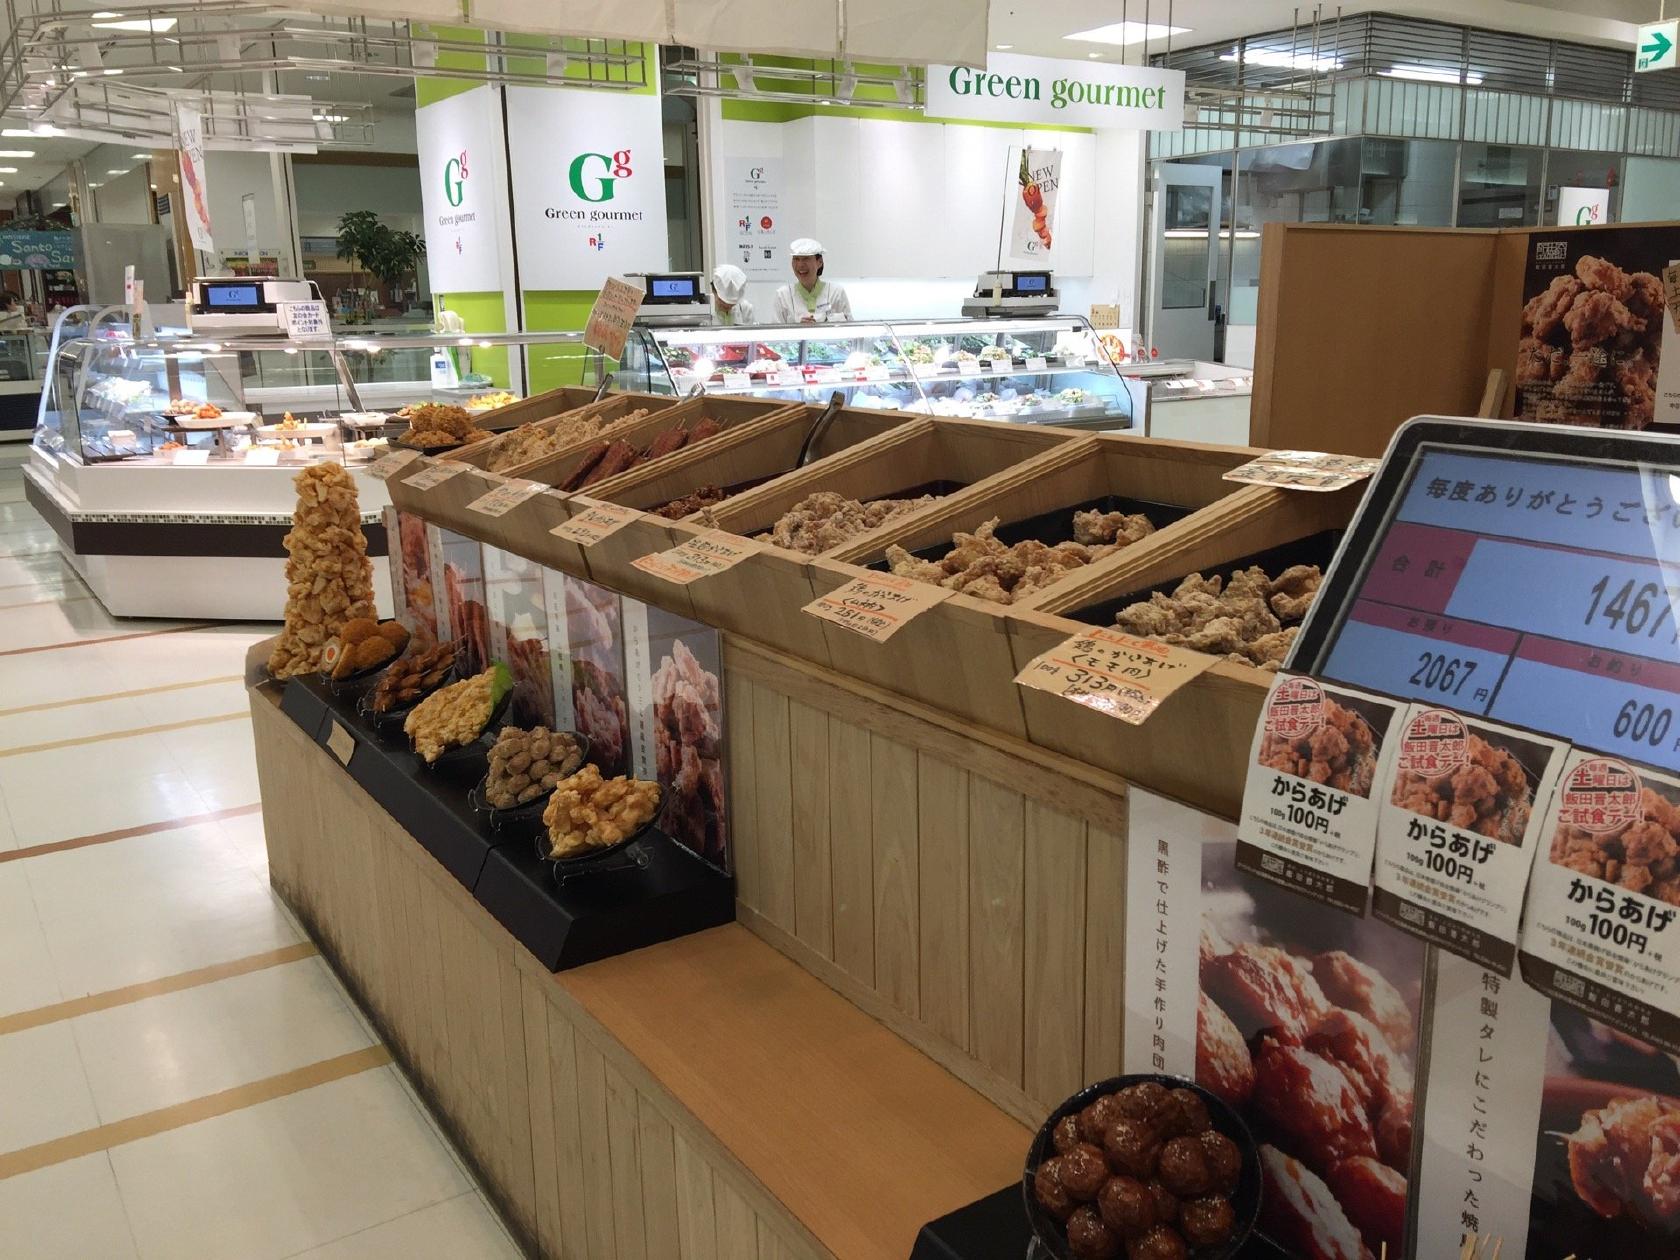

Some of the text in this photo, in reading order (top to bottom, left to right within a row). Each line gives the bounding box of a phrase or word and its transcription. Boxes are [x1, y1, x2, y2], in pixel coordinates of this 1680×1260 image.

[949, 66, 1166, 109] Green gourmet
[1028, 178, 1059, 197] OPEN
[1031, 165, 1055, 182] NEW
[545, 207, 643, 222] Green gourmet
[11, 240, 53, 253] Santo
[1584, 575, 1680, 638] 1467
[1276, 686, 1320, 701] 土曜日は
[1408, 651, 1489, 702] 2067 円
[1410, 719, 1462, 735] 土曜日は
[1613, 699, 1673, 746] 600
[1271, 776, 1349, 815] からあげ
[1572, 768, 1630, 786] 土曜日は
[1270, 807, 1286, 820] 100g
[1287, 804, 1330, 834] 100円
[1407, 818, 1497, 864] からあげ
[1406, 852, 1424, 866] 100g
[1425, 850, 1474, 884] 100円
[1567, 878, 1677, 933] からあげ
[1565, 915, 1587, 932] 100g
[1589, 913, 1649, 955] 100円
[1152, 839, 1170, 1079] 黒酢で仕上げた手作り肉団
[1460, 972, 1501, 1248] 特製タレにこだわった焼
